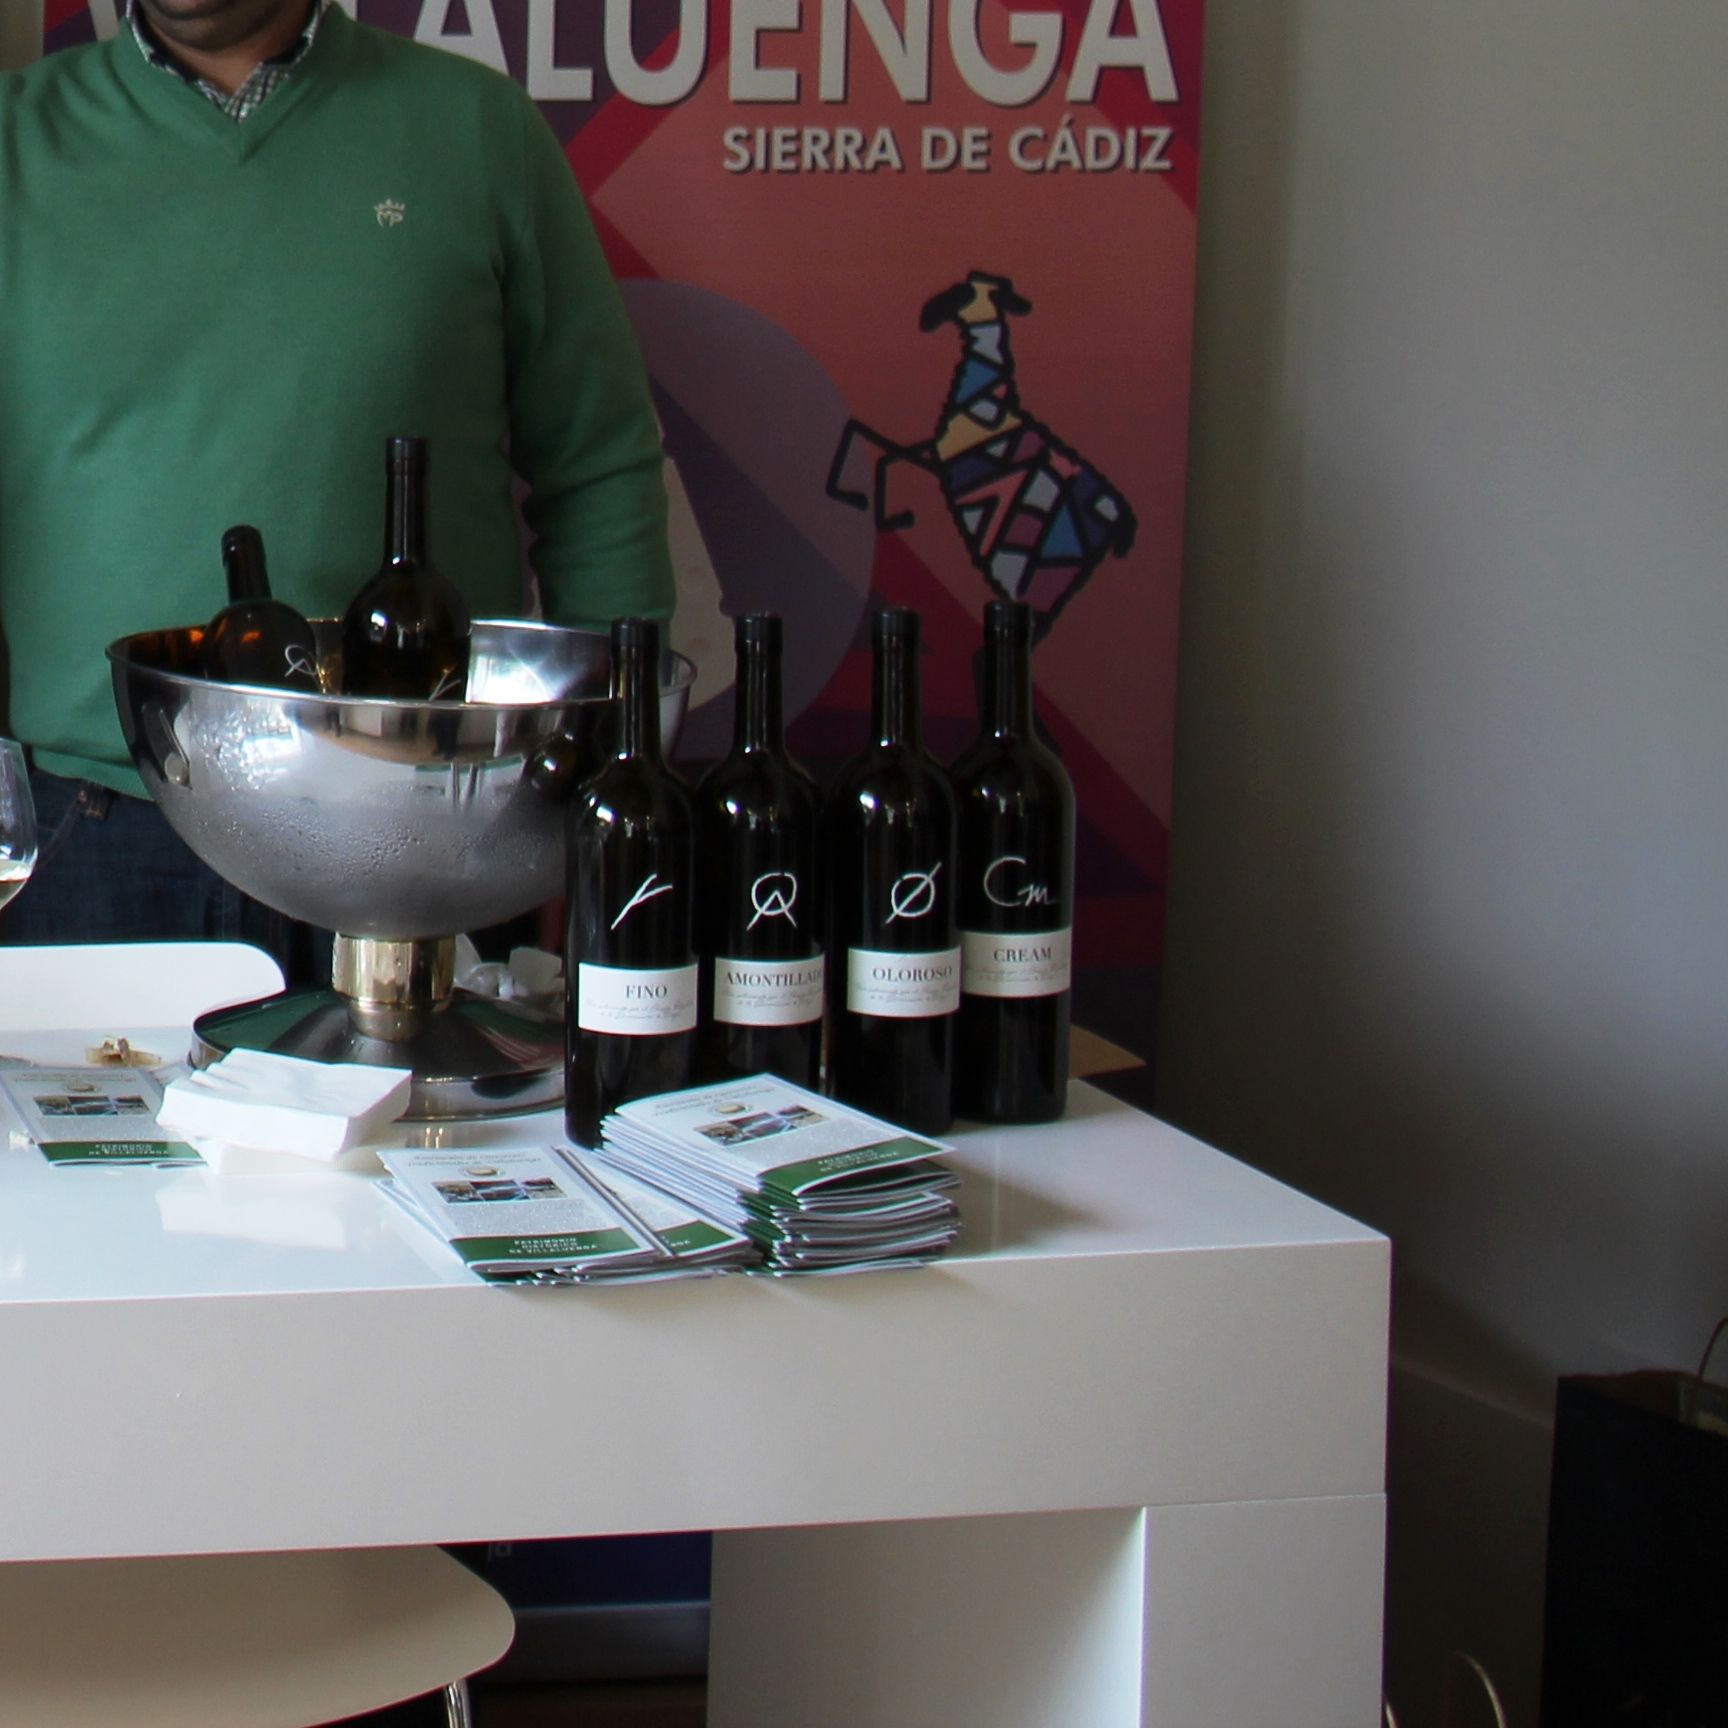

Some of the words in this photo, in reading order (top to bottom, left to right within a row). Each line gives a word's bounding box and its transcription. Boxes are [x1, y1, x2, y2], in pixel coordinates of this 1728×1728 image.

[722, 126, 902, 172] SIERRA
[922, 127, 990, 172] DE
[1007, 113, 1173, 172] CÁDIZ
[993, 947, 1052, 963] CREAM
[725, 971, 821, 988] AMONTILLAD
[872, 965, 953, 983] OLOROSO
[625, 984, 668, 1000] FINO
